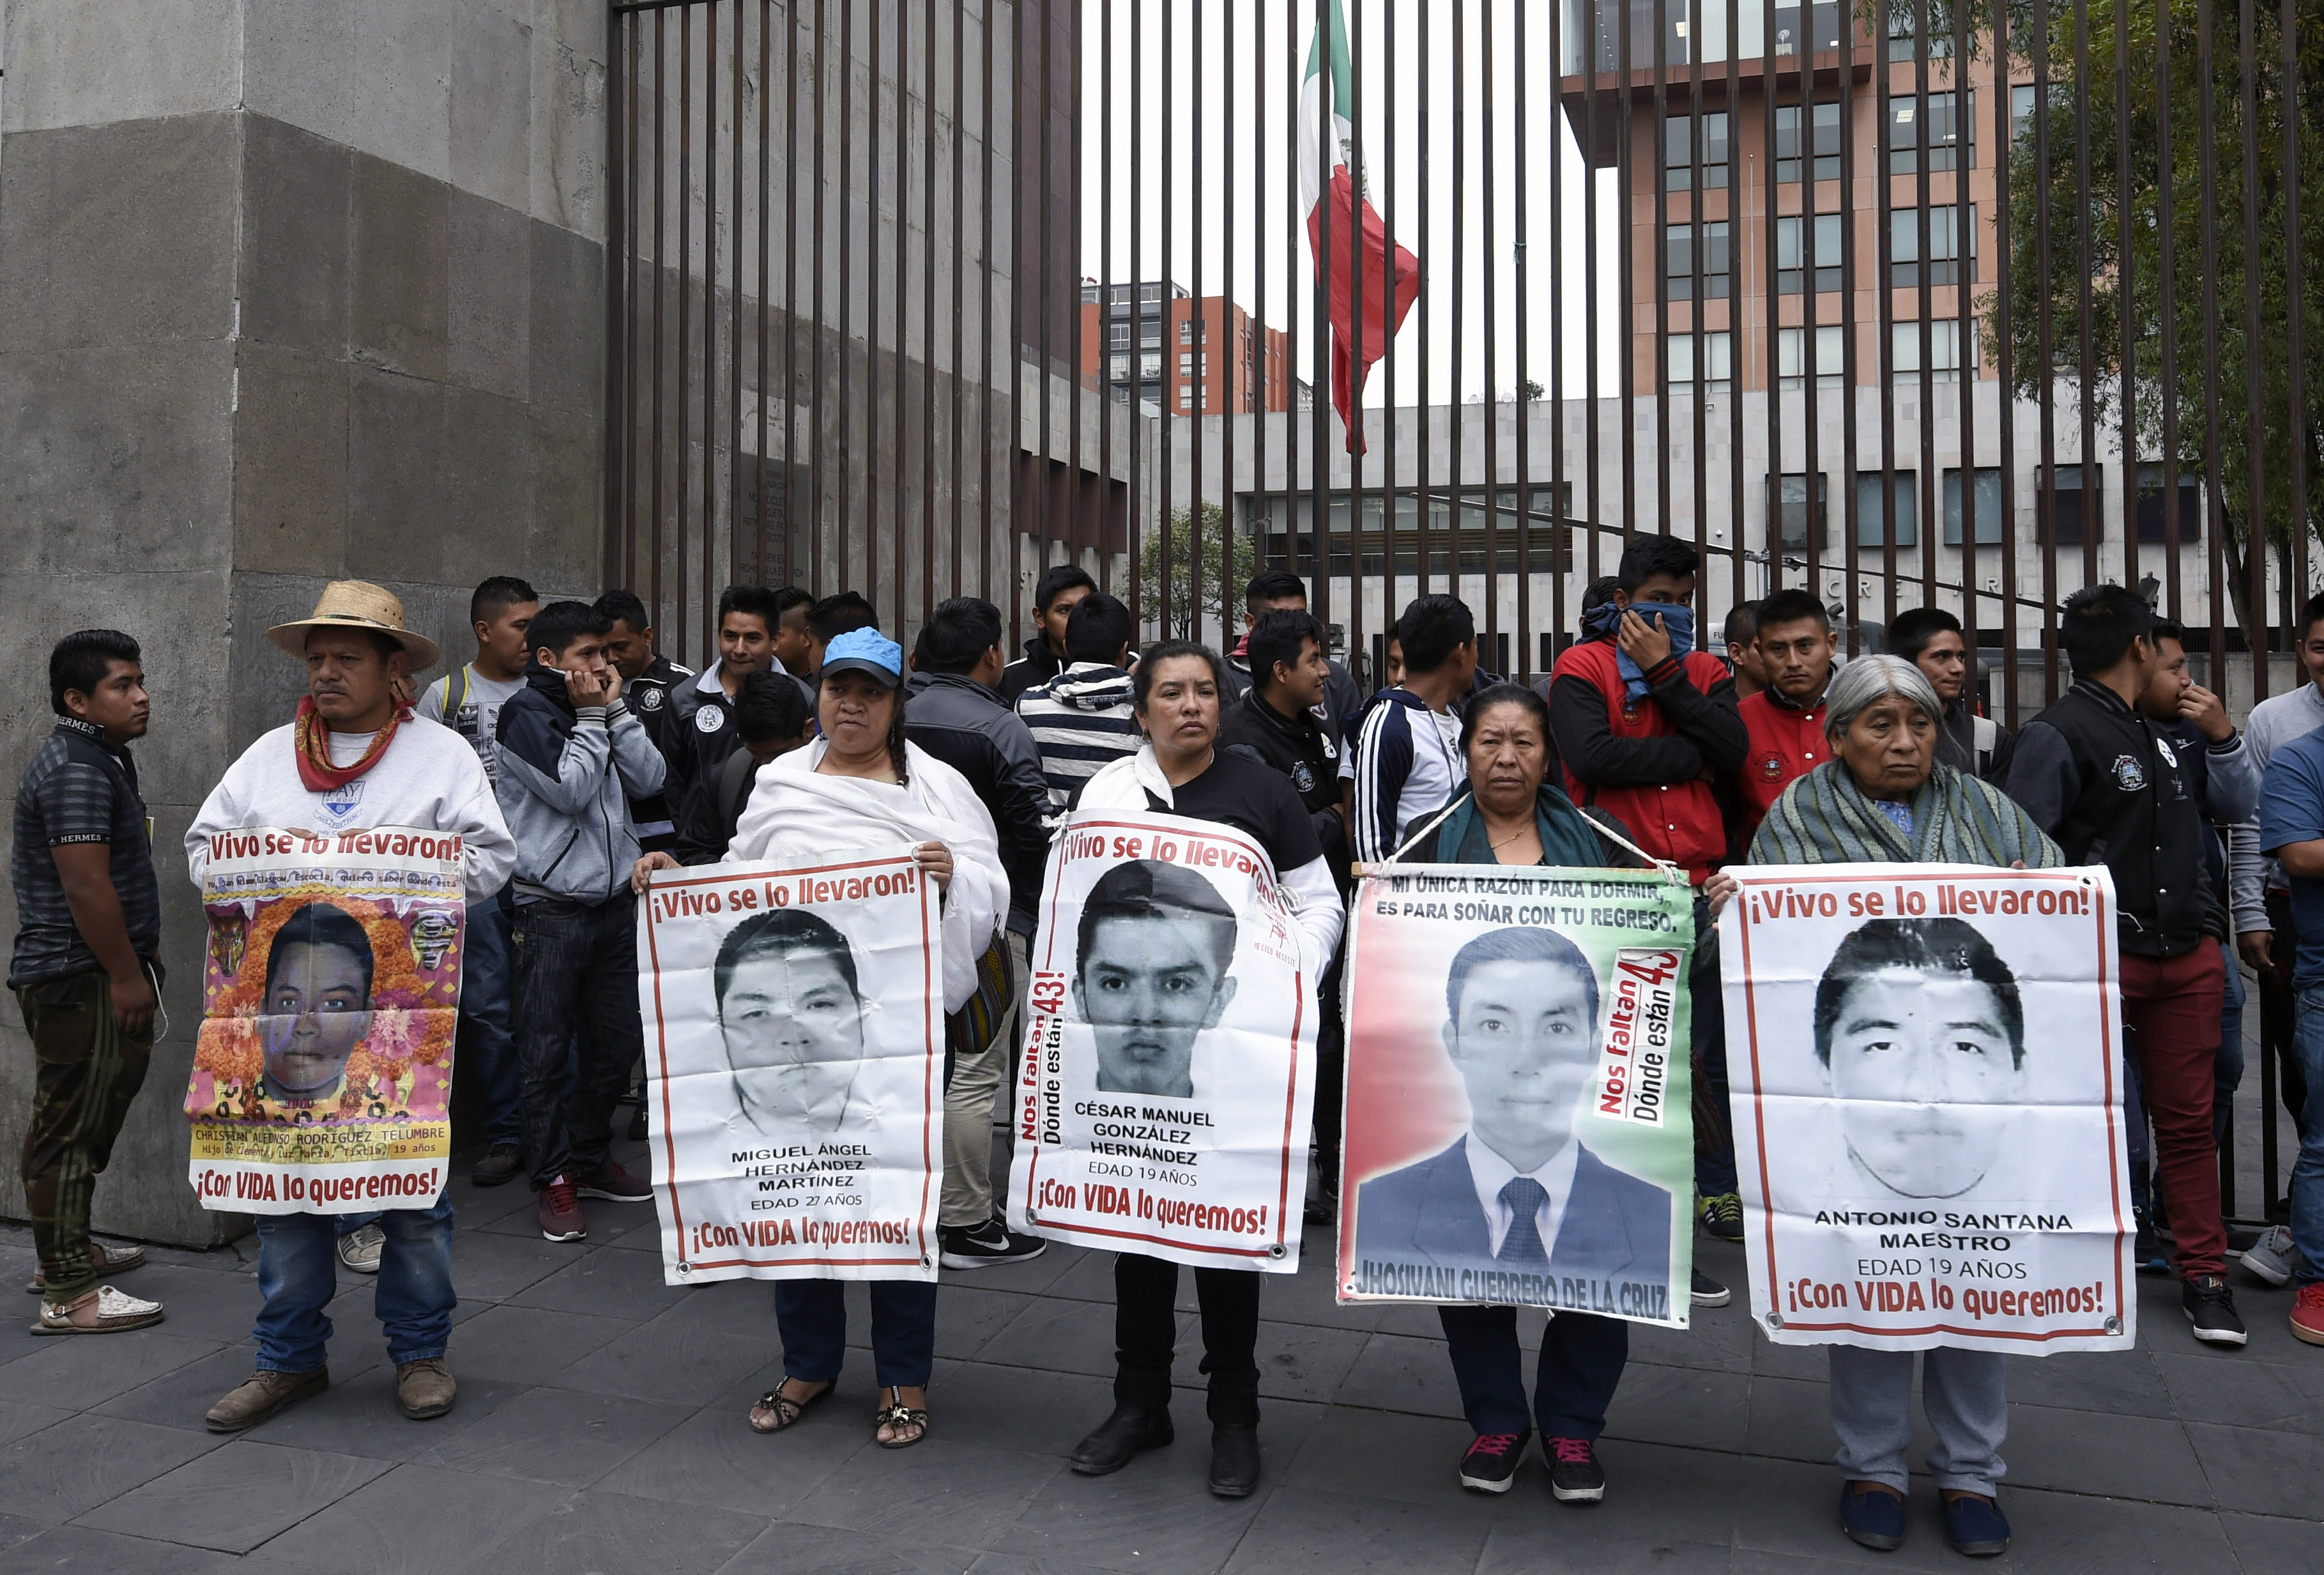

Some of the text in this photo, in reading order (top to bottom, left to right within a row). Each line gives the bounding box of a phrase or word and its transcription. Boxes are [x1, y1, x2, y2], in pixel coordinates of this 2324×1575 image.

[61, 834, 102, 843] HERMES
[265, 834, 294, 855] se
[302, 838, 329, 854] lo
[337, 833, 462, 861] llevaron!
[340, 873, 374, 884] quiero
[378, 873, 404, 883] saber
[1064, 834, 1105, 866] ¡Vivo
[1112, 836, 1142, 859] se
[1151, 835, 1177, 863] lo
[1185, 840, 1277, 910] llevaron!
[654, 866, 916, 924] ¡Vivo se lo llevaron!
[1391, 871, 1665, 905] MI ÚNICA RAZÓN PARA DORMIR,
[1376, 898, 1678, 933] ES PARA SOÑAR CON TU REGRESO.
[1752, 883, 2090, 925] ¡Vivo se lo llevaron!
[1607, 980, 1637, 1057] faltan
[1021, 971, 1066, 1141] Nos faltan 43!
[1633, 989, 1671, 1123] Dónde están
[1043, 1018, 1063, 1145] Dónde están
[1600, 1065, 1626, 1115] Nos
[1074, 1102, 1216, 1127] CÉSAR MANUEL
[195, 1130, 248, 1142] CHRISTIAN
[252, 1132, 290, 1145] ALFONSO
[381, 1128, 445, 1141] TELUMBRE
[1093, 1123, 1191, 1145] GONZÁLEZ
[203, 1145, 221, 1156] Hijo
[224, 1145, 234, 1155] de
[270, 1150, 275, 1160] y
[278, 1149, 294, 1158] Luz
[394, 1144, 406, 1153] 19
[412, 1144, 436, 1153] años
[731, 1142, 872, 1164] MIGUEL ÁNGEL
[1090, 1141, 1198, 1167] HERNÁNDEZ
[745, 1159, 866, 1178] HERNÁNDEZ
[1088, 1161, 1198, 1187] EDAD 19 AÑOS
[197, 1167, 438, 1207] ¡Con VIDA lo queremos!
[758, 1174, 855, 1192] MARTÍNEZ
[751, 1193, 863, 1211] EDAD 27 AÑOS
[1038, 1178, 1268, 1236] ¡Con VIDA lo queremos!
[1814, 1210, 2073, 1231] ANTONIO SANTANA
[692, 1217, 911, 1254] ¡Con VIDA lo queremos!
[1879, 1233, 2012, 1251] MAESTRO
[1858, 1257, 2028, 1280] EDAD 19 AÑOS
[1356, 1259, 1670, 1321] JHOSIVANI GUERRERO DE LA CRUZ
[1788, 1277, 2104, 1321] ¡Con VIDA lo queremos!
